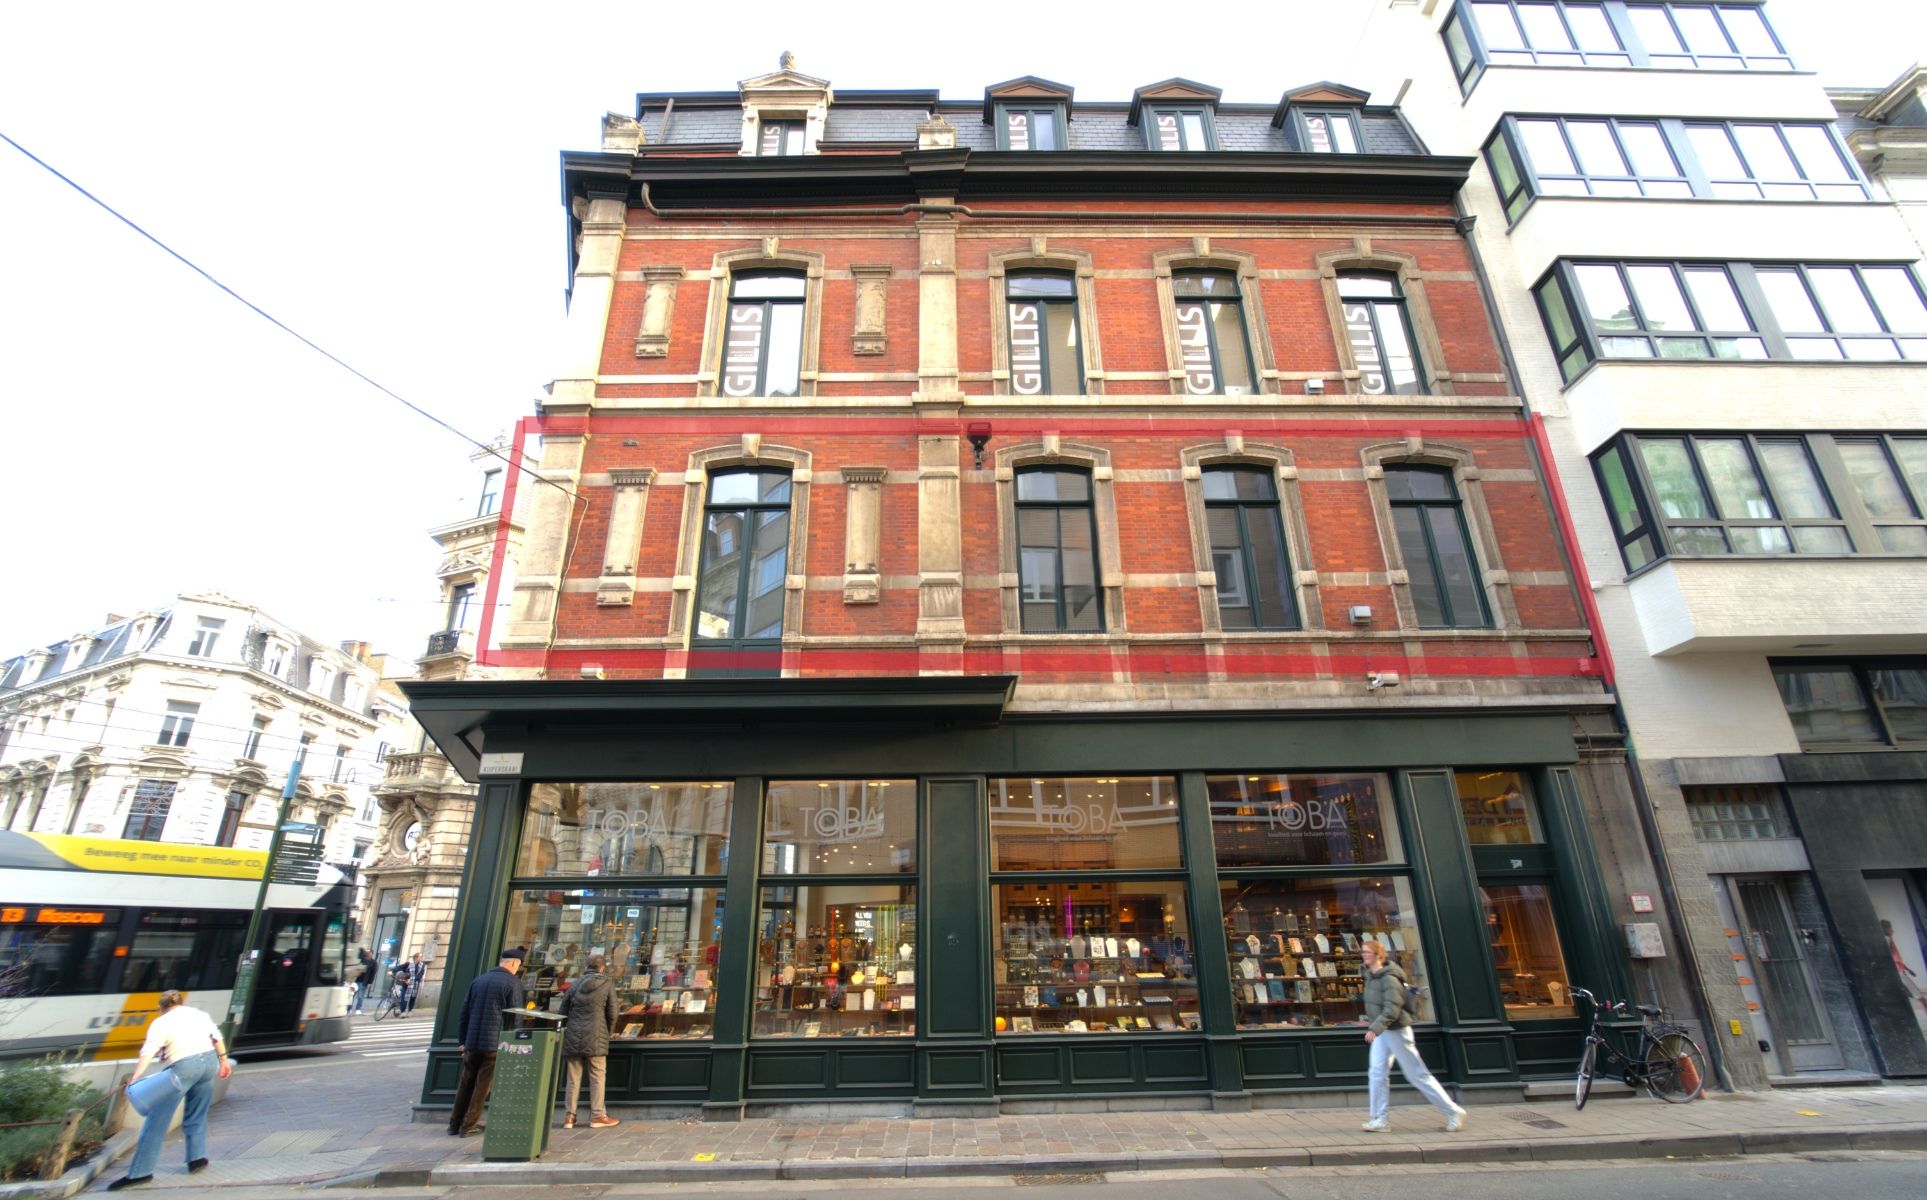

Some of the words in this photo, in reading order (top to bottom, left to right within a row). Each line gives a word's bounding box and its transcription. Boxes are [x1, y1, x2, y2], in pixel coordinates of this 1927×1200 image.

[723, 307, 763, 396] GILLIS
[1010, 305, 1041, 394] GILLIS
[1176, 307, 1215, 394] GILLIS
[1344, 306, 1385, 394] GILLIS
[587, 809, 668, 839] TOBA
[799, 806, 880, 837] TOBA
[1042, 803, 1128, 834] TOBA
[1262, 799, 1348, 830] TOBA
[84, 847, 138, 861] Beweeg
[141, 853, 167, 861] mee
[172, 854, 198, 863] naar
[202, 855, 241, 866] minder
